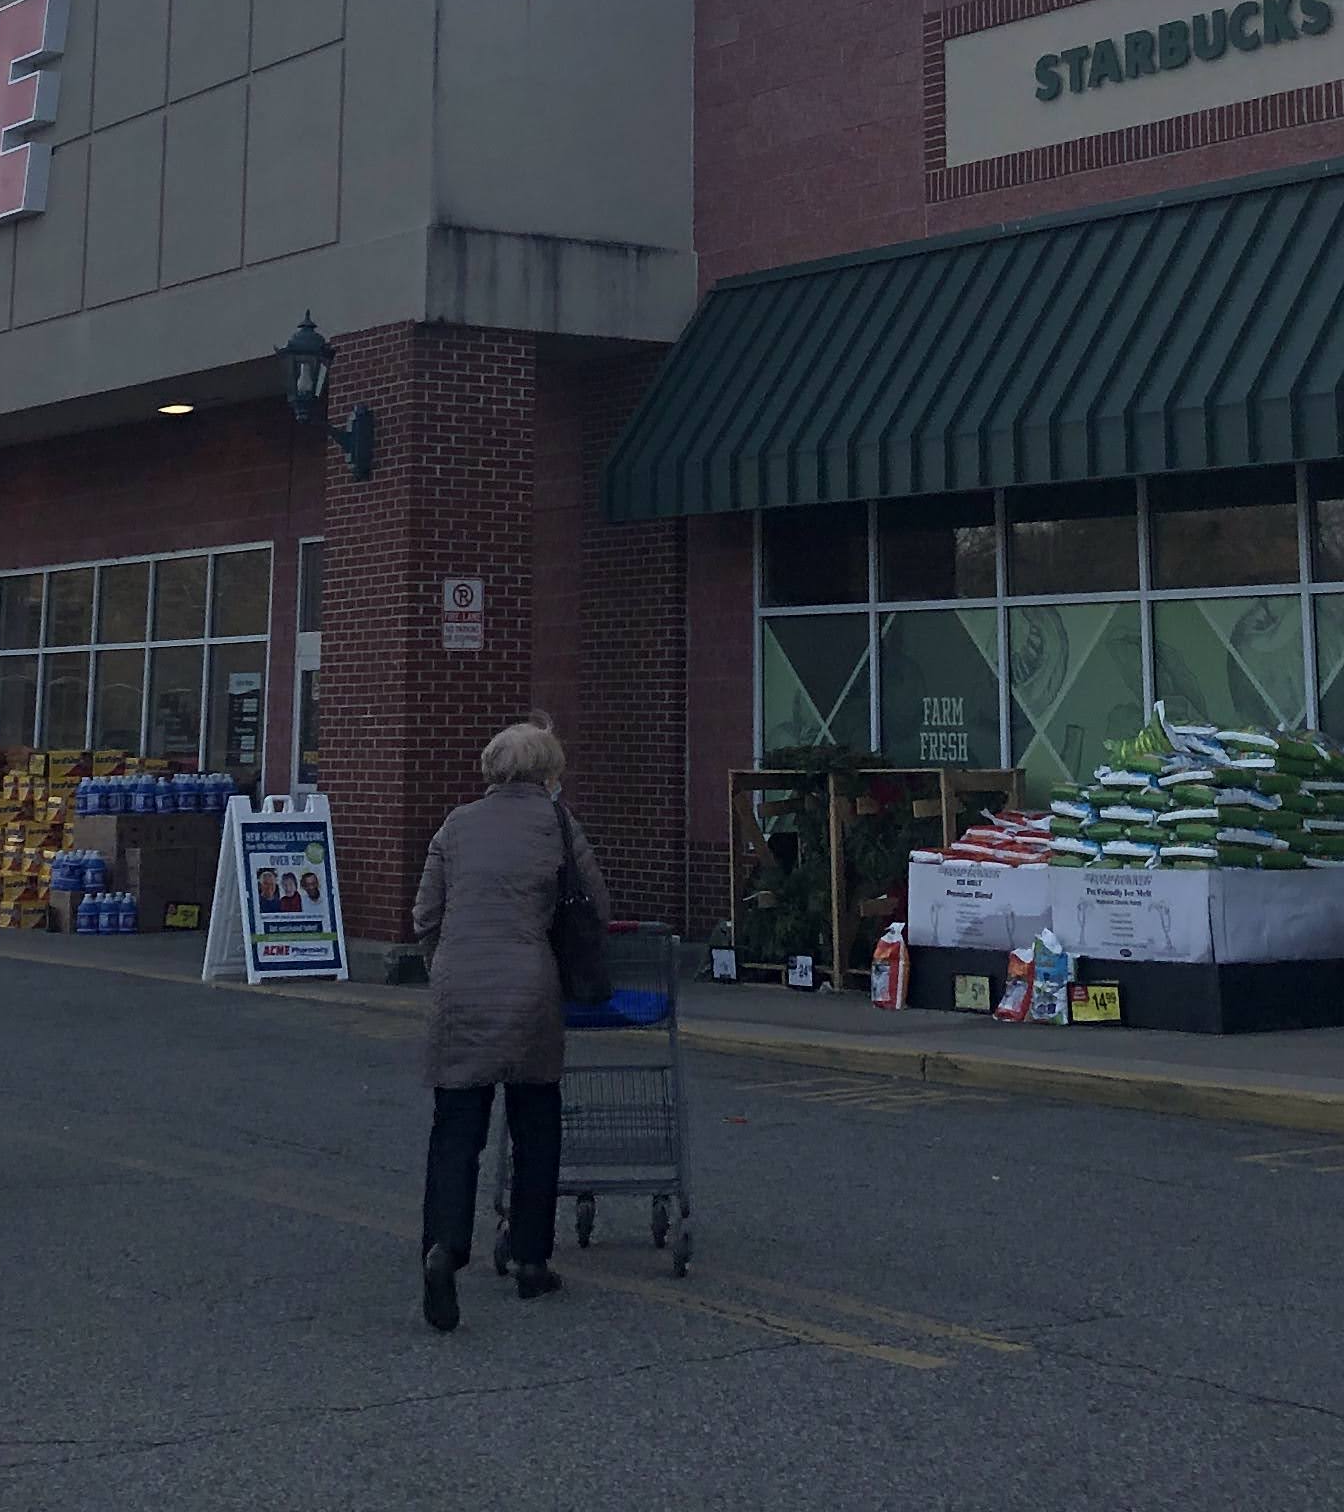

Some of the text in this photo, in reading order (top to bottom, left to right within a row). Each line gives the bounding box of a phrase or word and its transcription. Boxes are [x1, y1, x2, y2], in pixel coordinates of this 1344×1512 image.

[922, 696, 964, 726] FARM
[919, 731, 969, 762] FRESH
[245, 831, 261, 842] NEW
[263, 945, 290, 956] ACME
